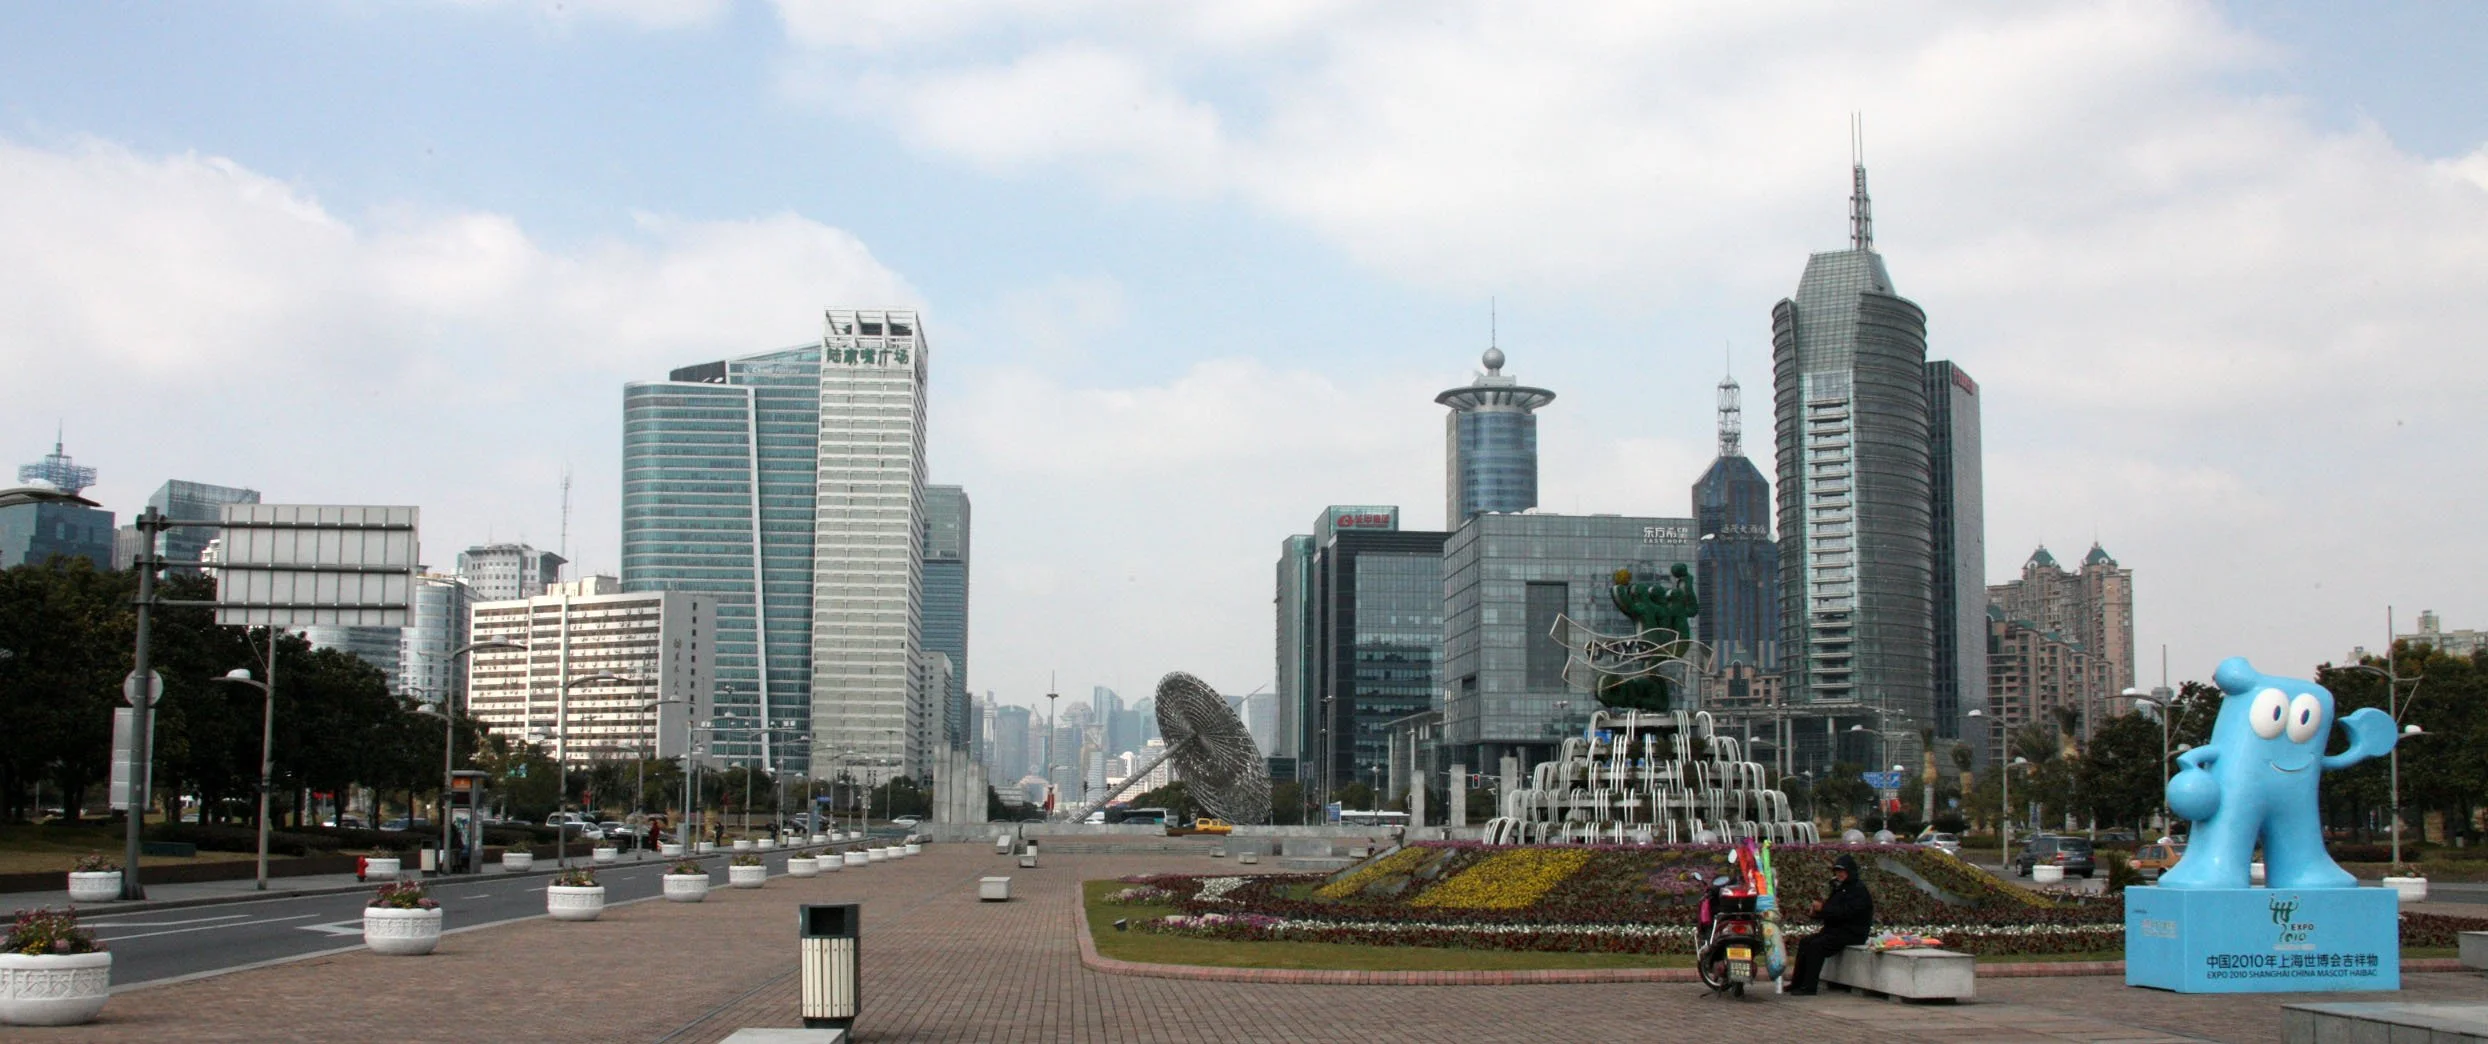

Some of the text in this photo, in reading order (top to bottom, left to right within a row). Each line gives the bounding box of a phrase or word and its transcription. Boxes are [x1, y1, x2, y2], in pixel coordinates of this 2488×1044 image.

[826, 347, 910, 367] 陆家嘴广场
[2291, 923, 2314, 931] EXPO
[2207, 954, 2378, 969] 中国2010年上海世博会吉祥物
[2207, 971, 2228, 979] EXPO
[2229, 971, 2248, 979] 2010
[2249, 970, 2290, 978] SHANGHAI
[2291, 969, 2316, 978] CHINA
[2317, 969, 2348, 978] MASCOT
